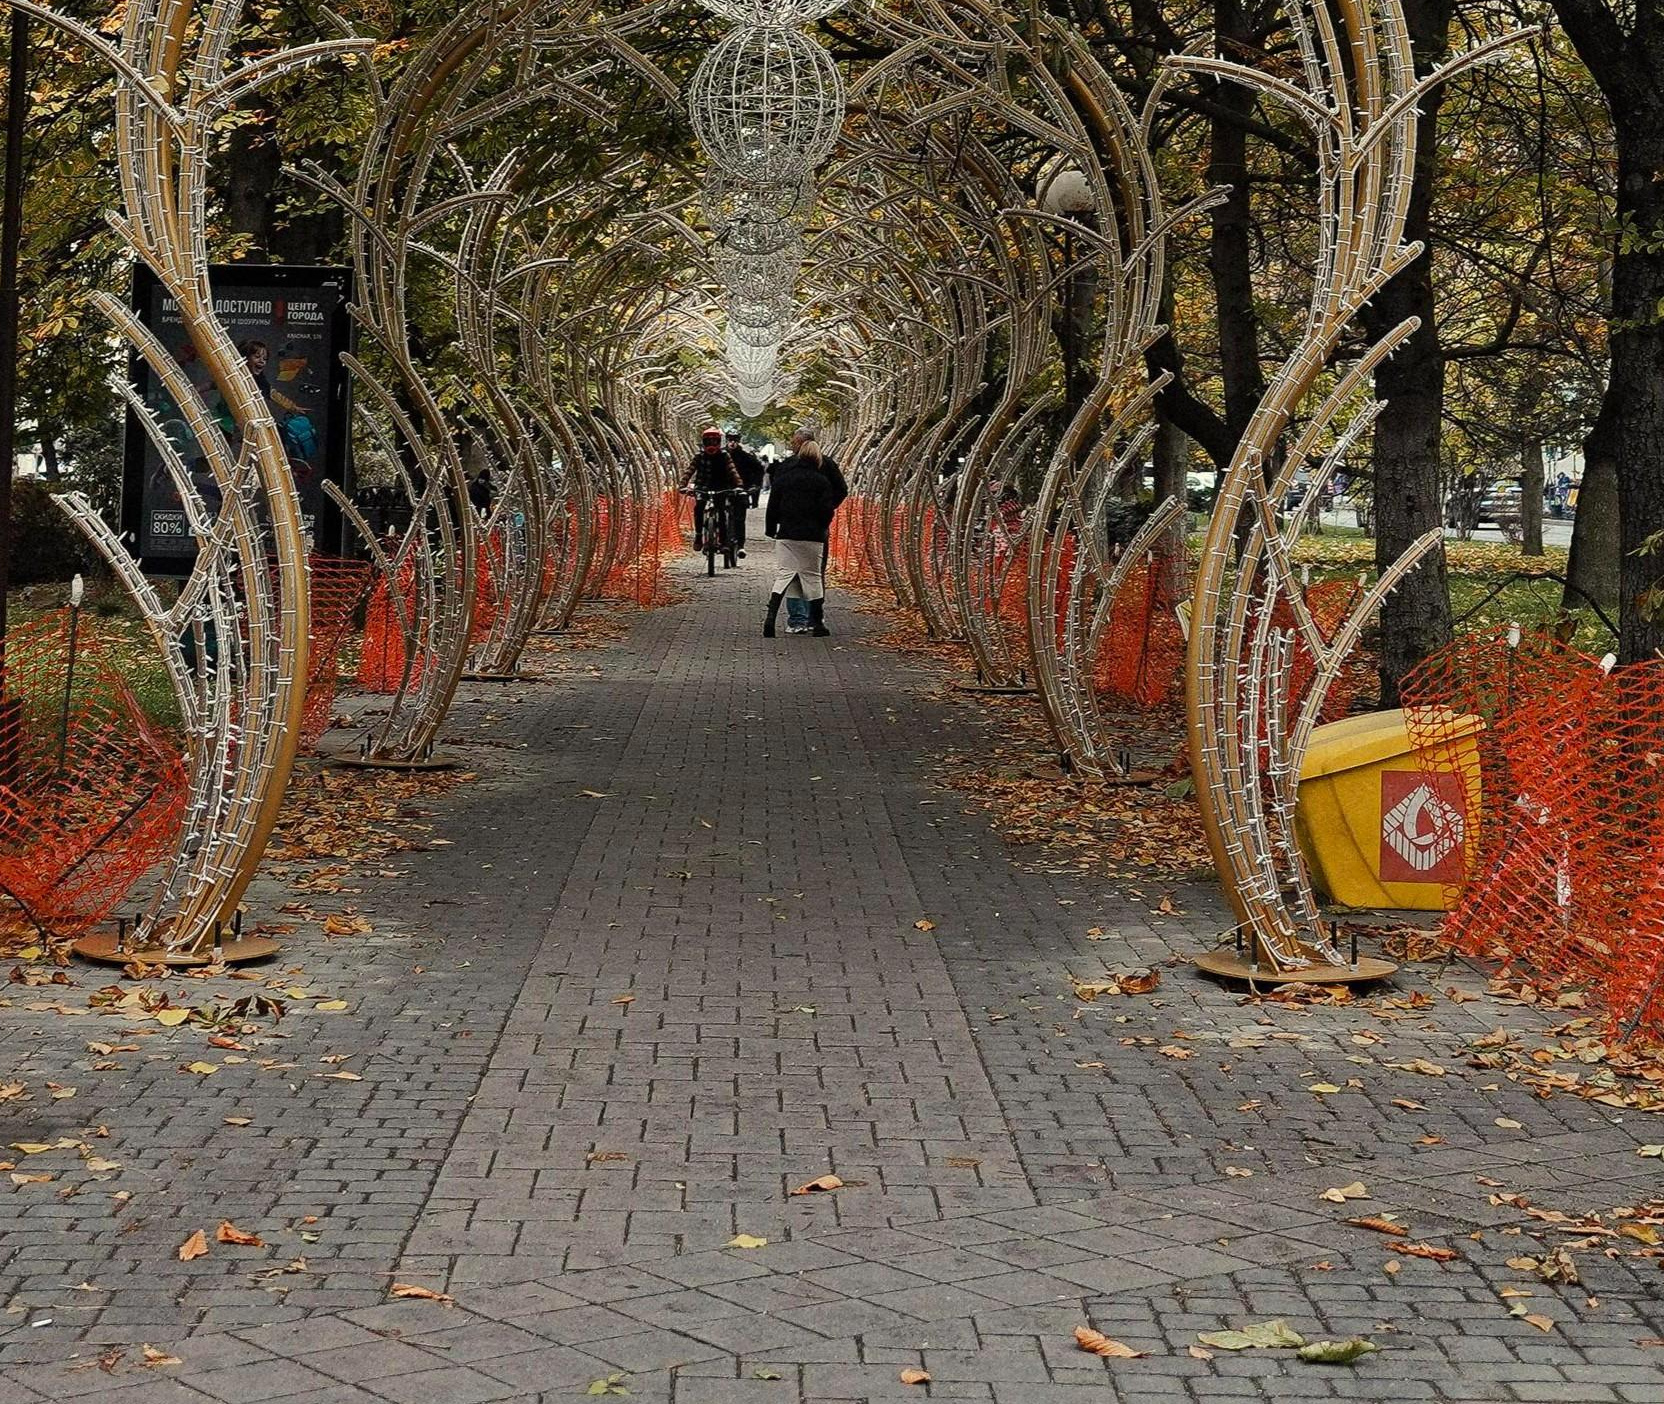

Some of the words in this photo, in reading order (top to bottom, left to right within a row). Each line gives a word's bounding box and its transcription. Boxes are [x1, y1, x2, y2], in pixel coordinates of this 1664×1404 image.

[214, 299, 272, 315] ДОСТУПНО
[287, 302, 318, 311] ЦЕНТР
[287, 311, 324, 321] ГОРОДА
[153, 521, 182, 534] 80%
